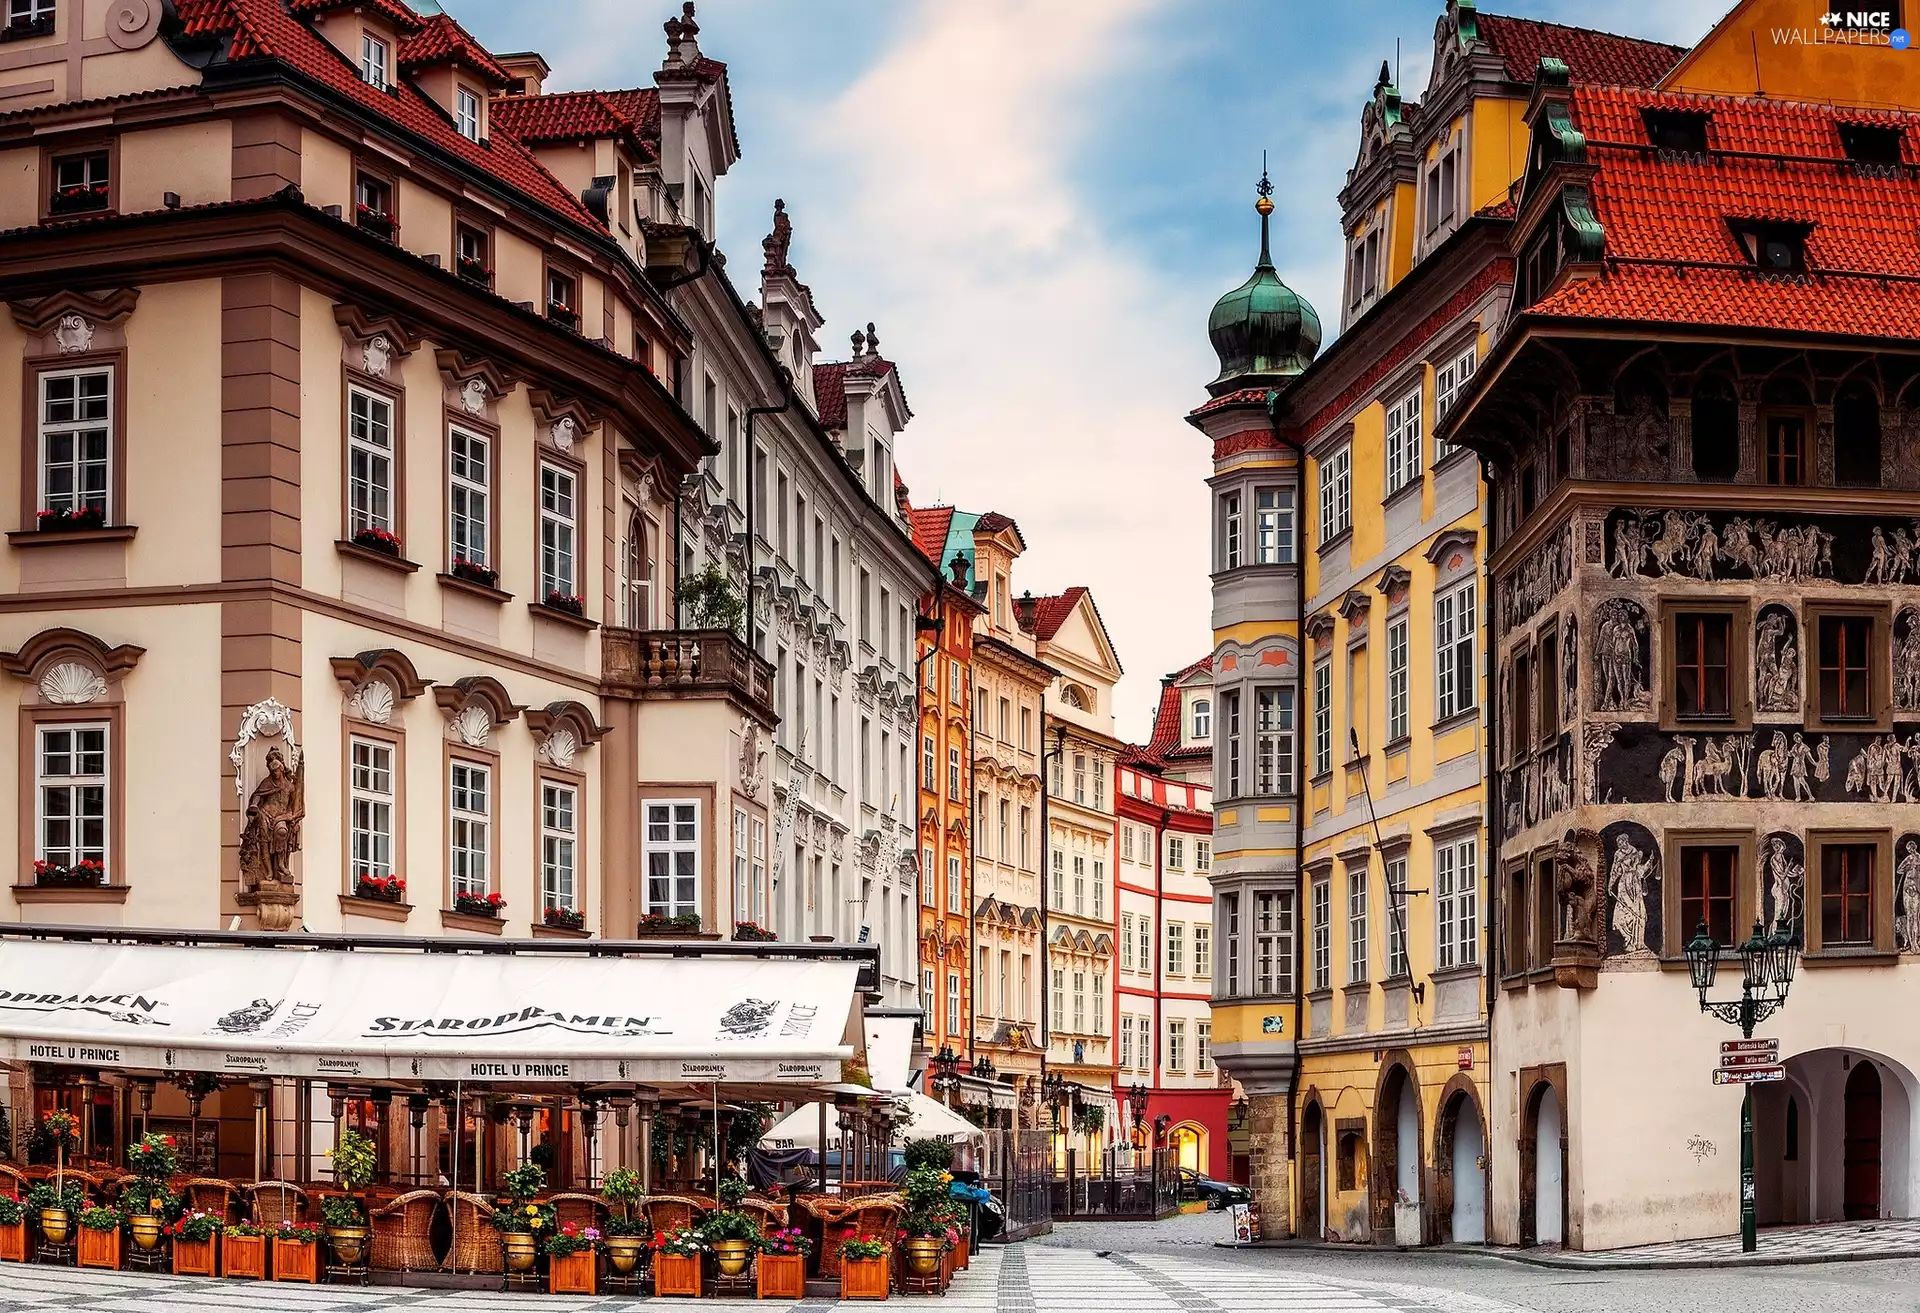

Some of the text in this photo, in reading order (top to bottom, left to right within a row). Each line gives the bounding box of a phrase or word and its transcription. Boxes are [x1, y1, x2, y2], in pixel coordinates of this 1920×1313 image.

[369, 1006, 650, 1031] STAROPRAMEN
[30, 1045, 120, 1061] HOTEL U PRINCE
[471, 1063, 569, 1077] HOTEL U PRINCE
[775, 1139, 795, 1149] BAR
[936, 1134, 954, 1144] BAR
